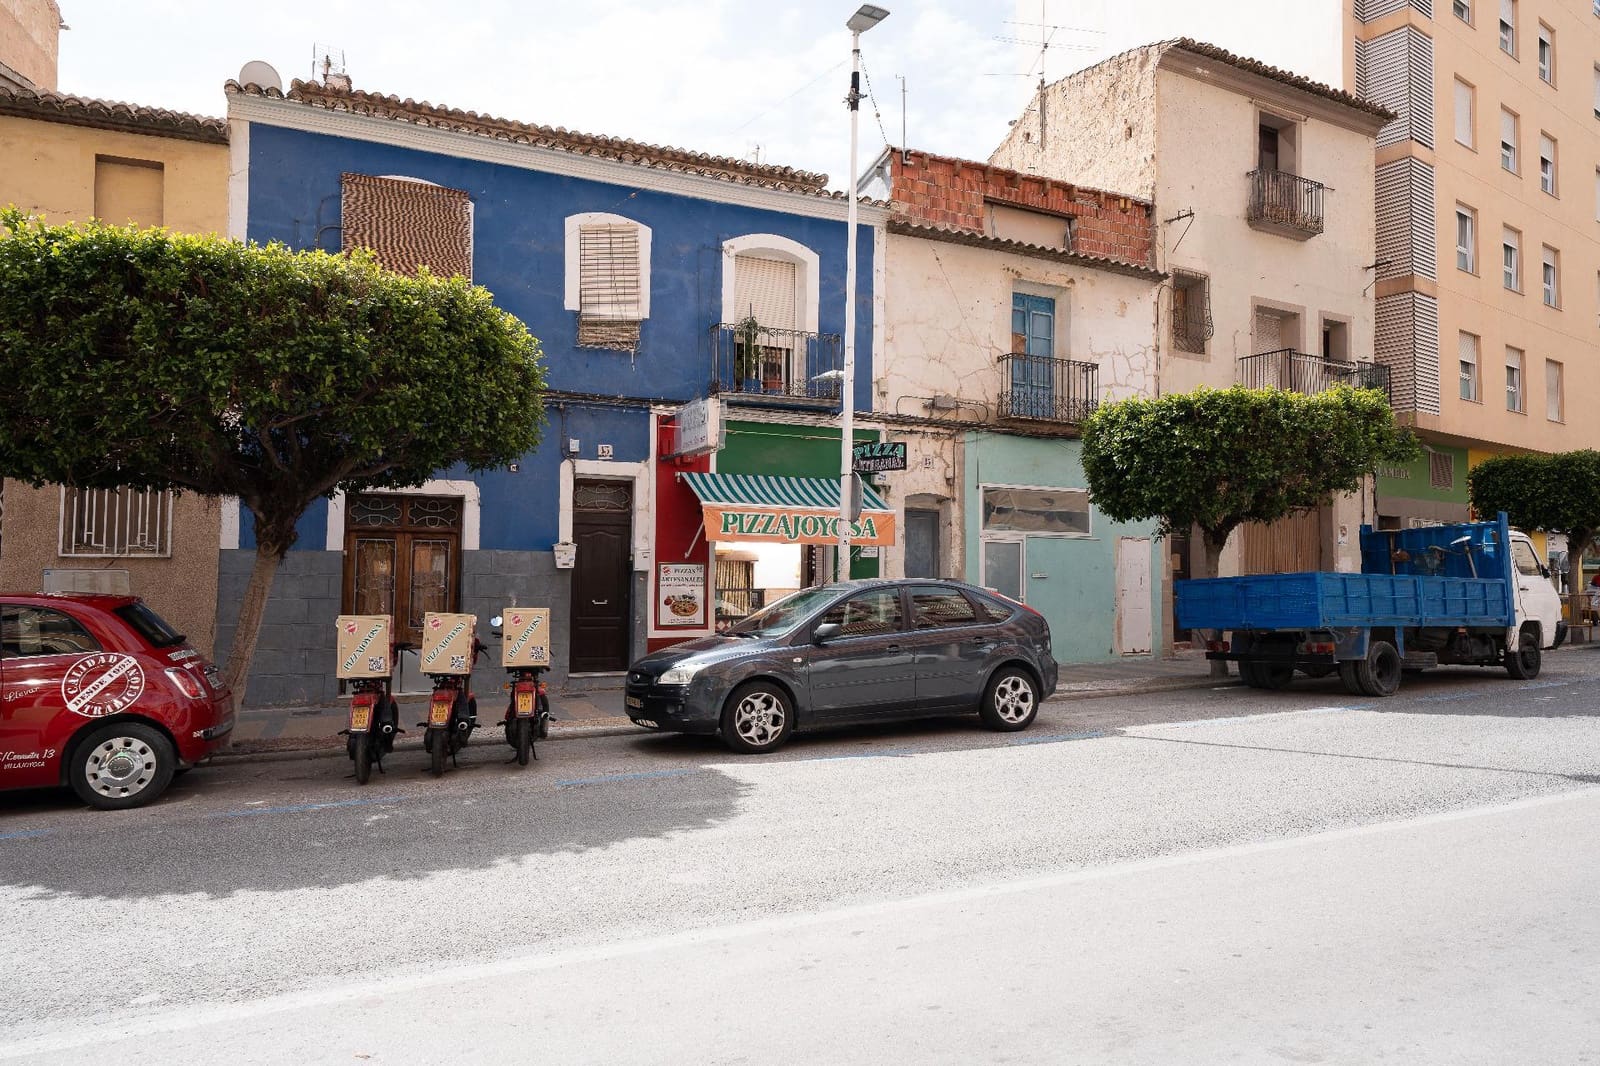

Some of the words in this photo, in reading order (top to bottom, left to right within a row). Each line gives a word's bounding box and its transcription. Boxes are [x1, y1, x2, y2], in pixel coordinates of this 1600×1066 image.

[853, 443, 905, 460] PIZZA
[67, 655, 118, 695] CALIDAD
[71, 678, 107, 707] DESDE
[42, 748, 56, 759] 13
